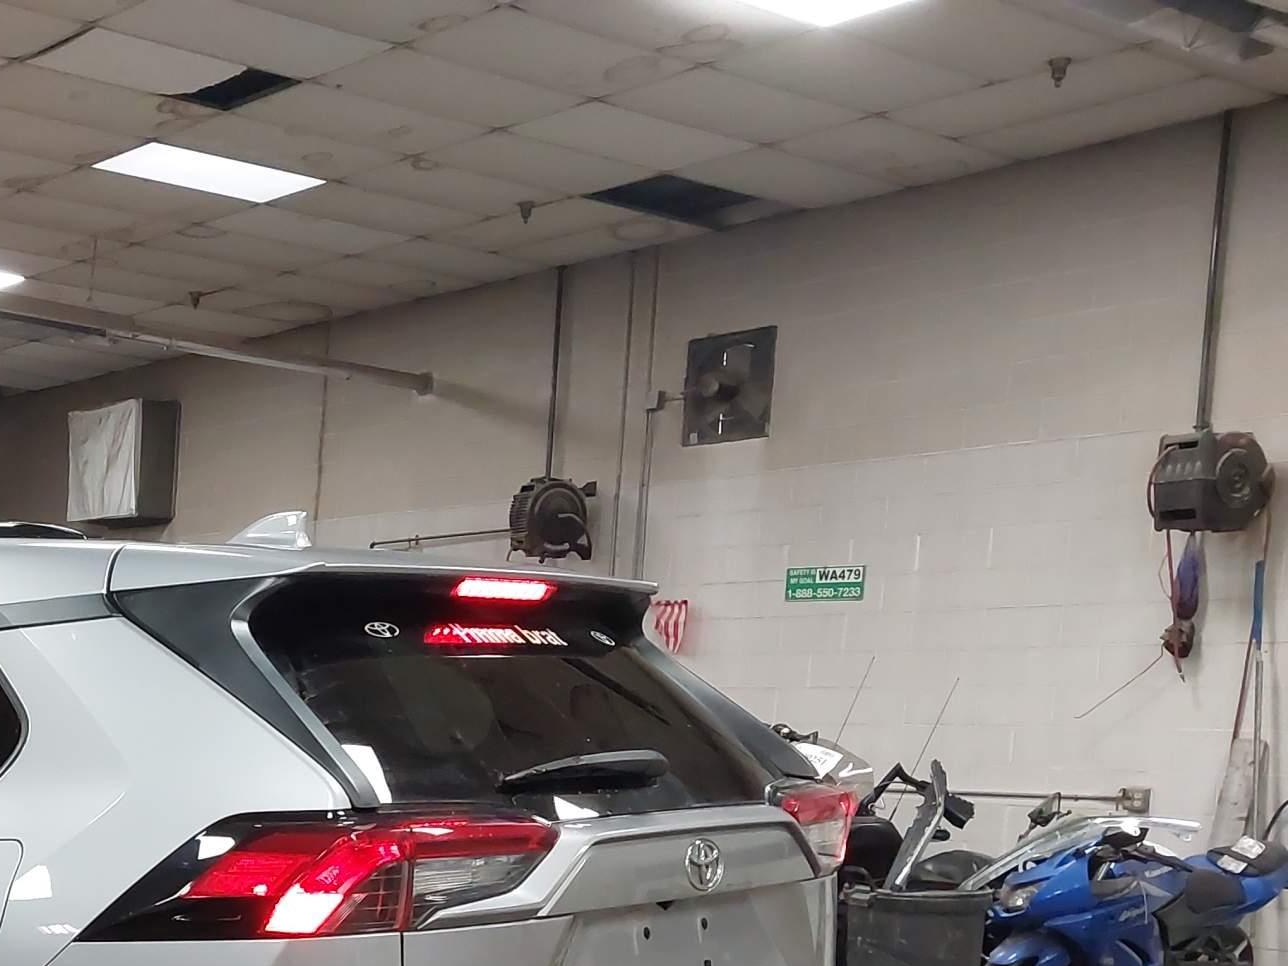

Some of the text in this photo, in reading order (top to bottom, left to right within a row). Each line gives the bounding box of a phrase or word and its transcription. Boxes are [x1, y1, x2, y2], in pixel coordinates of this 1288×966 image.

[818, 568, 861, 581] WA479
[787, 586, 861, 598] 1-888-550-7233
[514, 624, 569, 646] brat
